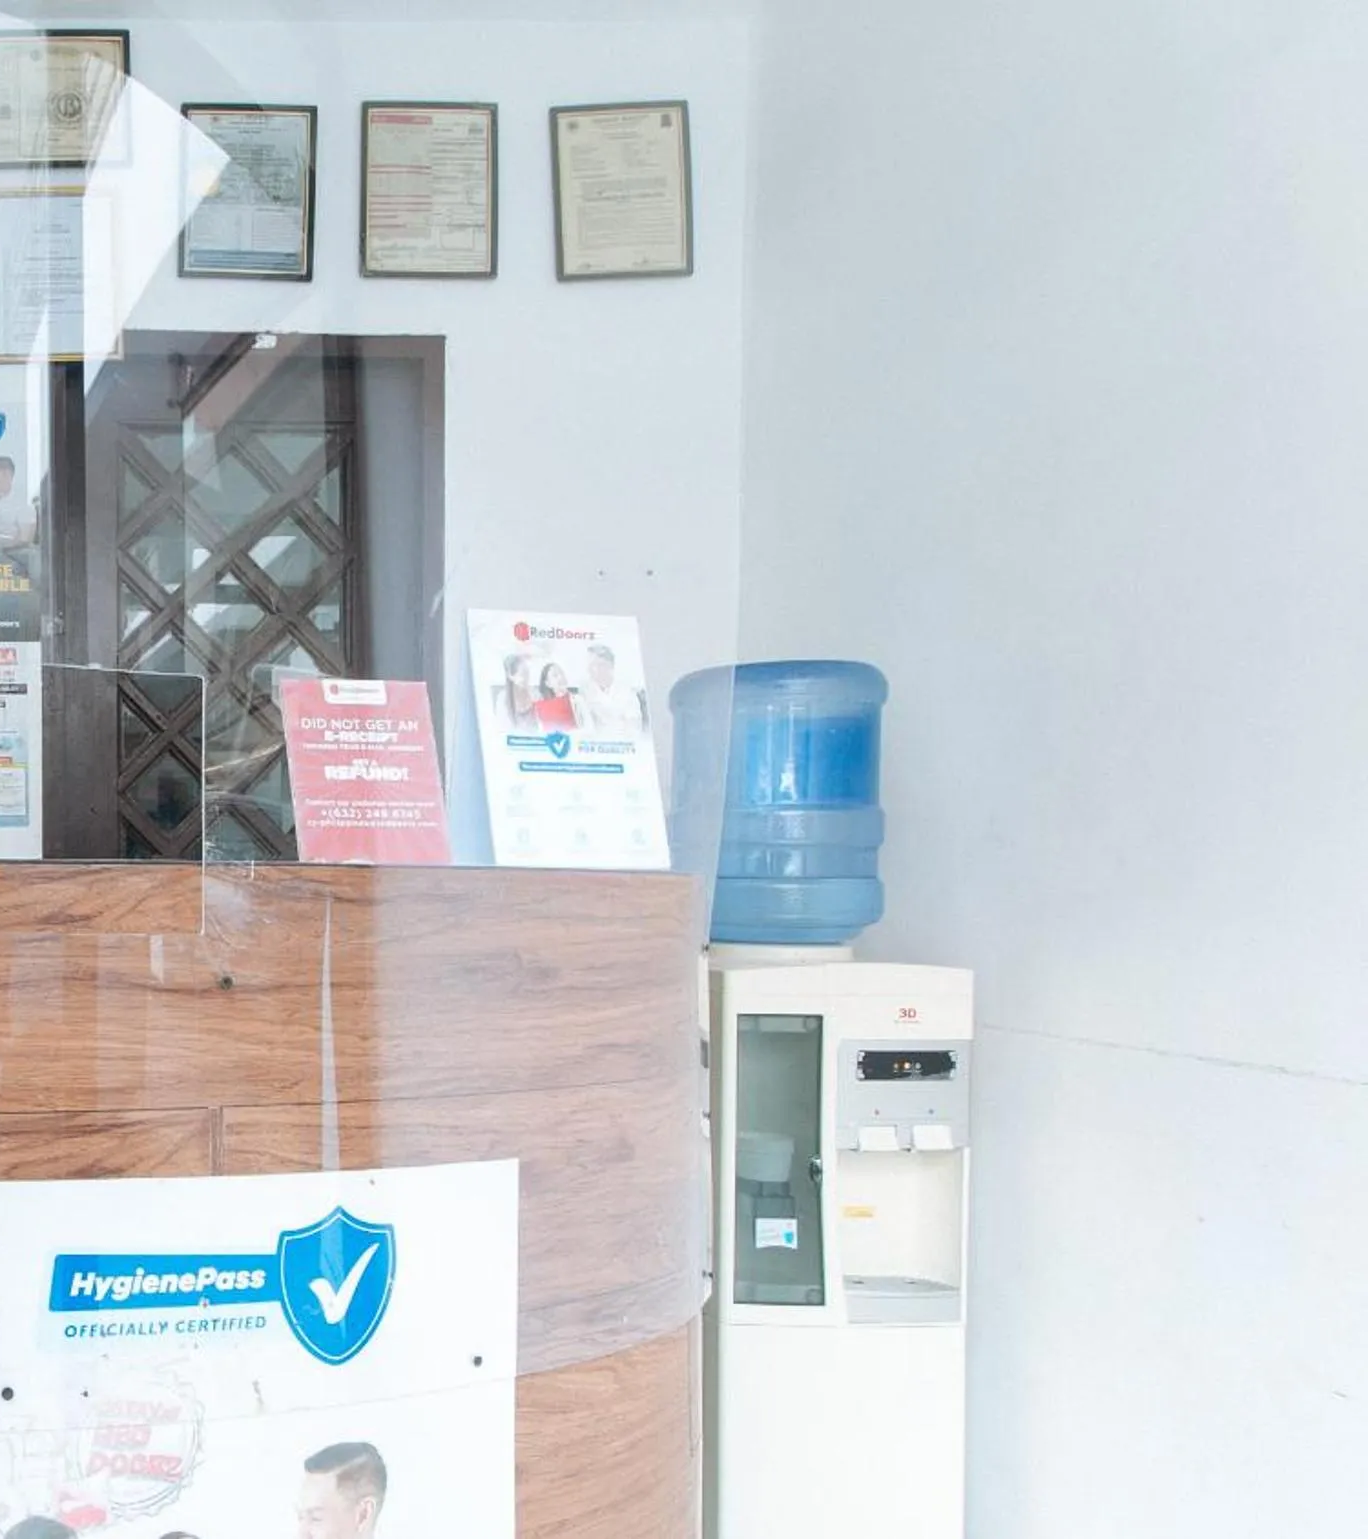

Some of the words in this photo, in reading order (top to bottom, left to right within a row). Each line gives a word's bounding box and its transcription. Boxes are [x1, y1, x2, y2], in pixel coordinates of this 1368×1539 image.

[529, 625, 596, 641] RedDoorz
[300, 717, 328, 730] DID
[331, 717, 360, 730] NOT
[365, 718, 395, 732] GET
[398, 720, 419, 732] AN
[324, 730, 399, 743] E-RECEIPT
[323, 764, 409, 782] REFUND!
[898, 1006, 918, 1019] 3D
[69, 1265, 268, 1302] HygienePass
[63, 1320, 169, 1339] OFFICIALLY
[174, 1315, 268, 1335] CERTIFIED
